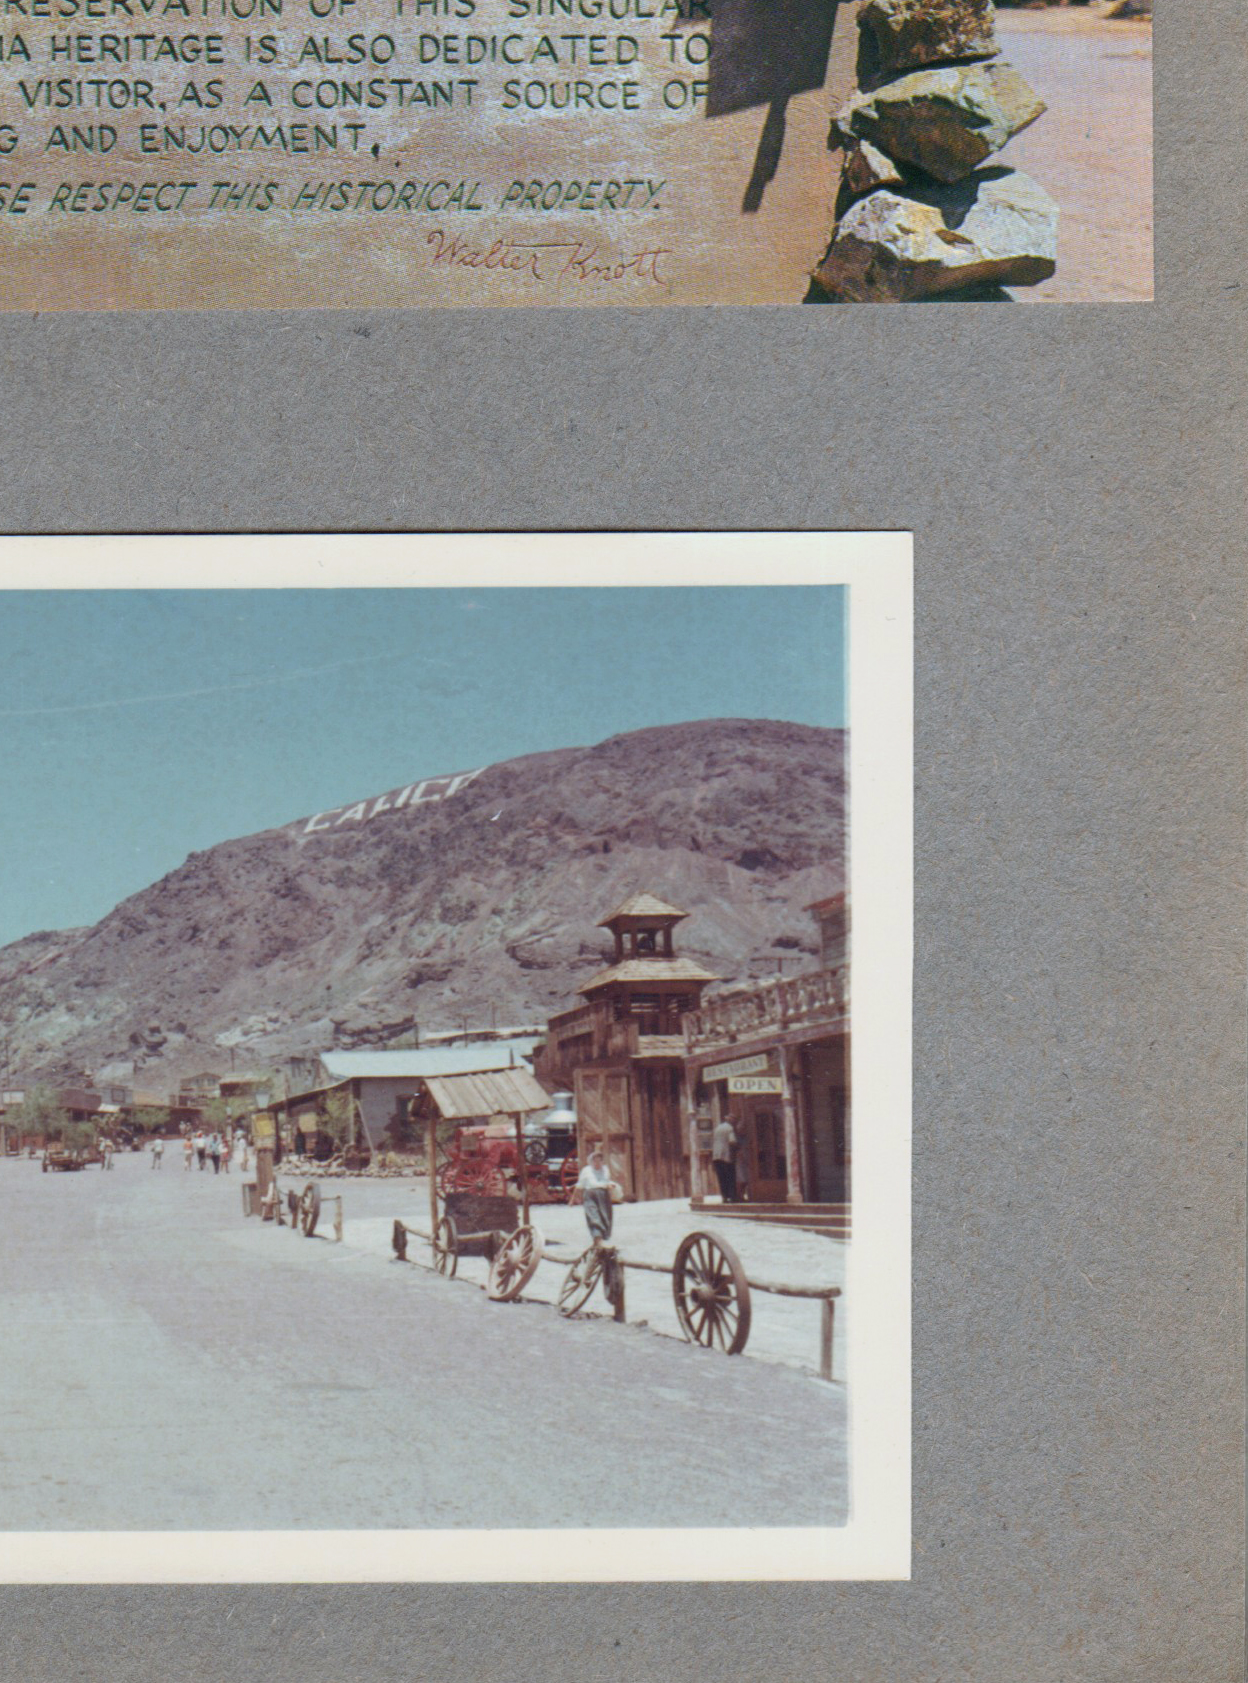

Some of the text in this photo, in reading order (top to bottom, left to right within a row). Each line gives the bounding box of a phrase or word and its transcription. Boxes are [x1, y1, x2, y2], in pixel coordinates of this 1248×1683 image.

[51, 35, 223, 64] HERITAGE
[245, 36, 277, 64] IS
[299, 35, 395, 64] ALSO
[420, 35, 638, 65] DEDICATED
[662, 35, 711, 65] TO
[180, 81, 222, 108] AS
[244, 82, 272, 108] A
[292, 80, 479, 108] CONSTANT
[502, 80, 640, 109] SOURCE
[663, 81, 708, 109] OF
[45, 125, 117, 152] AND
[49, 182, 196, 212] RESPECT
[208, 181, 277, 211] THIS
[293, 180, 482, 212] HISTORICAL
[502, 180, 667, 211] PROPERTY.
[427, 229, 673, 286] Walter Knott
[733, 1079, 777, 1091] OPEN
